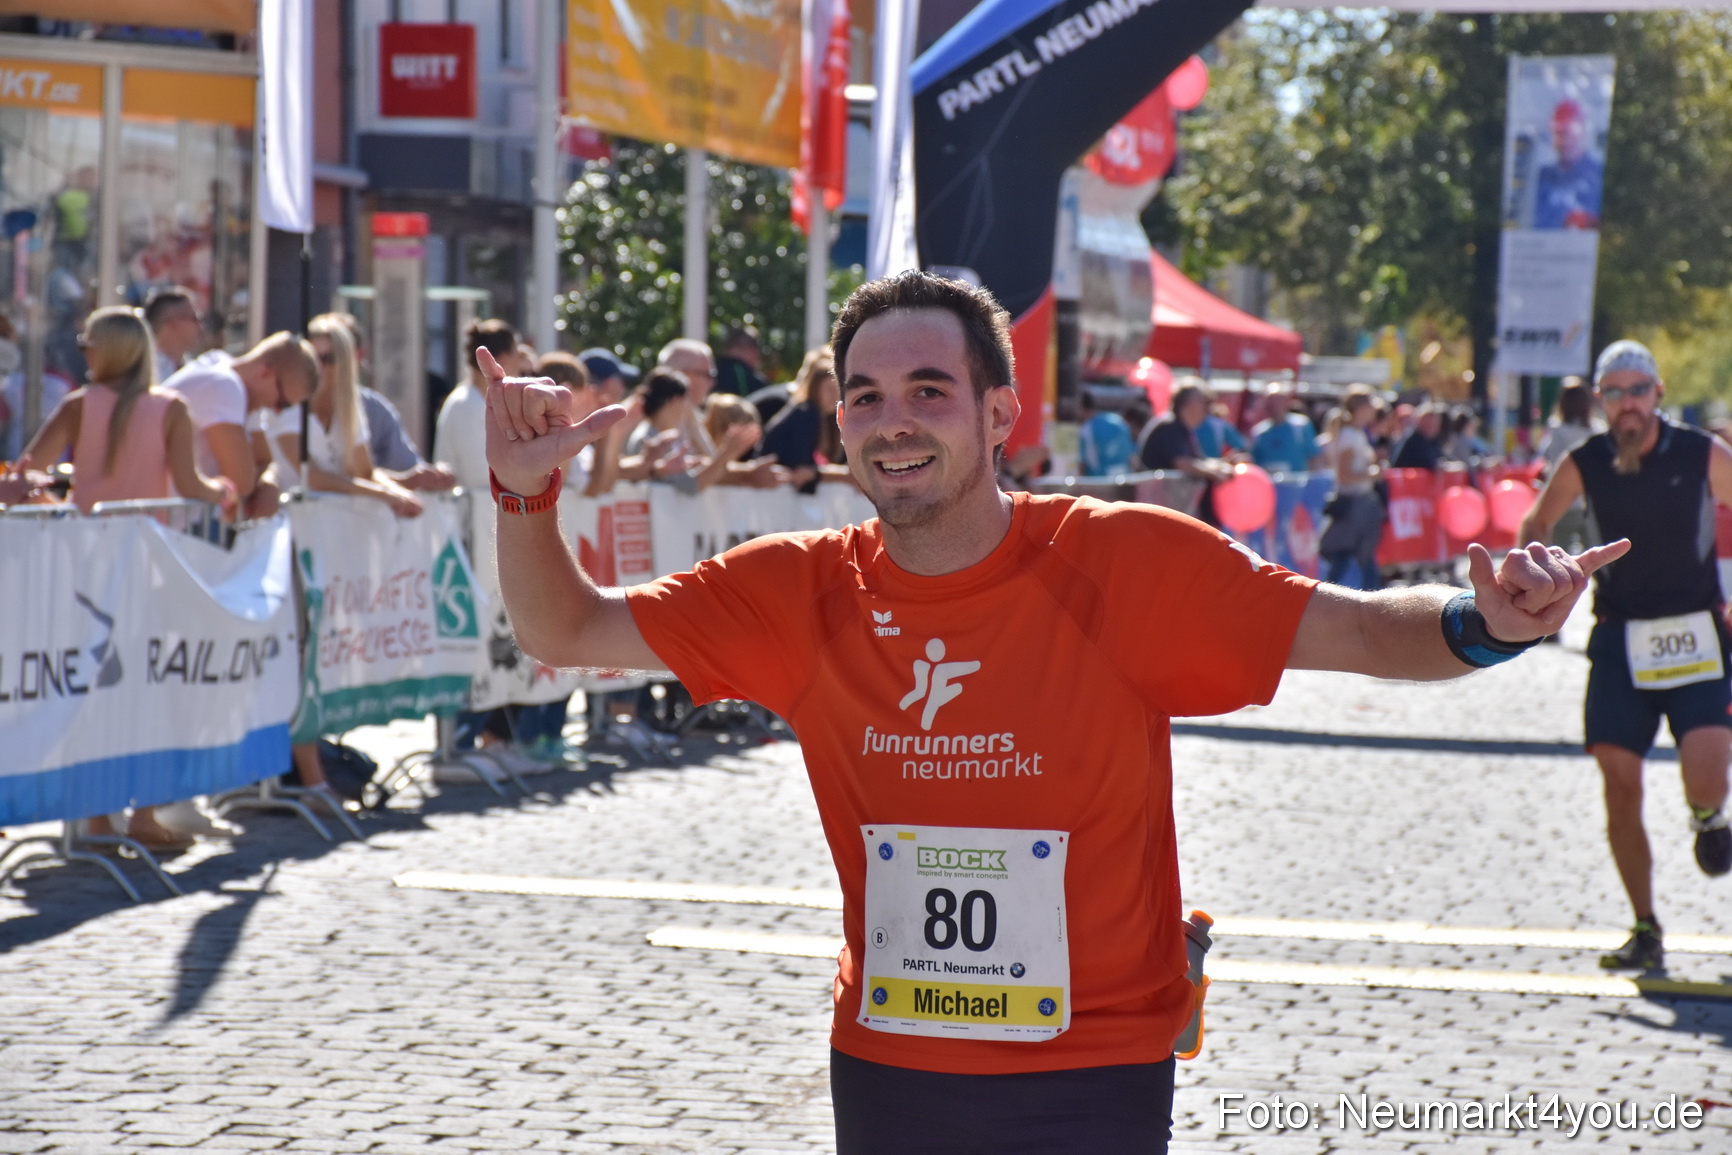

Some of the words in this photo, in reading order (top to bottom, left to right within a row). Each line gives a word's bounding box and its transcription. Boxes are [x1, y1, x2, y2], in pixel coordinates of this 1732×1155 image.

[391, 54, 459, 80] WITT
[937, 50, 1042, 122] PARTL
[1033, 0, 1160, 64] NEUMA
[0, 68, 81, 103] KT.DE
[1650, 631, 1697, 659] 309
[862, 726, 1015, 756] funrunners
[902, 751, 1043, 780] neumarkt
[917, 846, 1008, 872] BOCK
[916, 869, 943, 878] inspired
[944, 870, 953, 879] by
[954, 871, 975, 879] smart
[976, 872, 1009, 881] concepts
[923, 887, 998, 953] 80
[876, 932, 883, 944] B
[902, 958, 941, 973] PARTL
[943, 961, 1005, 976] Neumarkt
[913, 987, 1008, 1018] Michael
